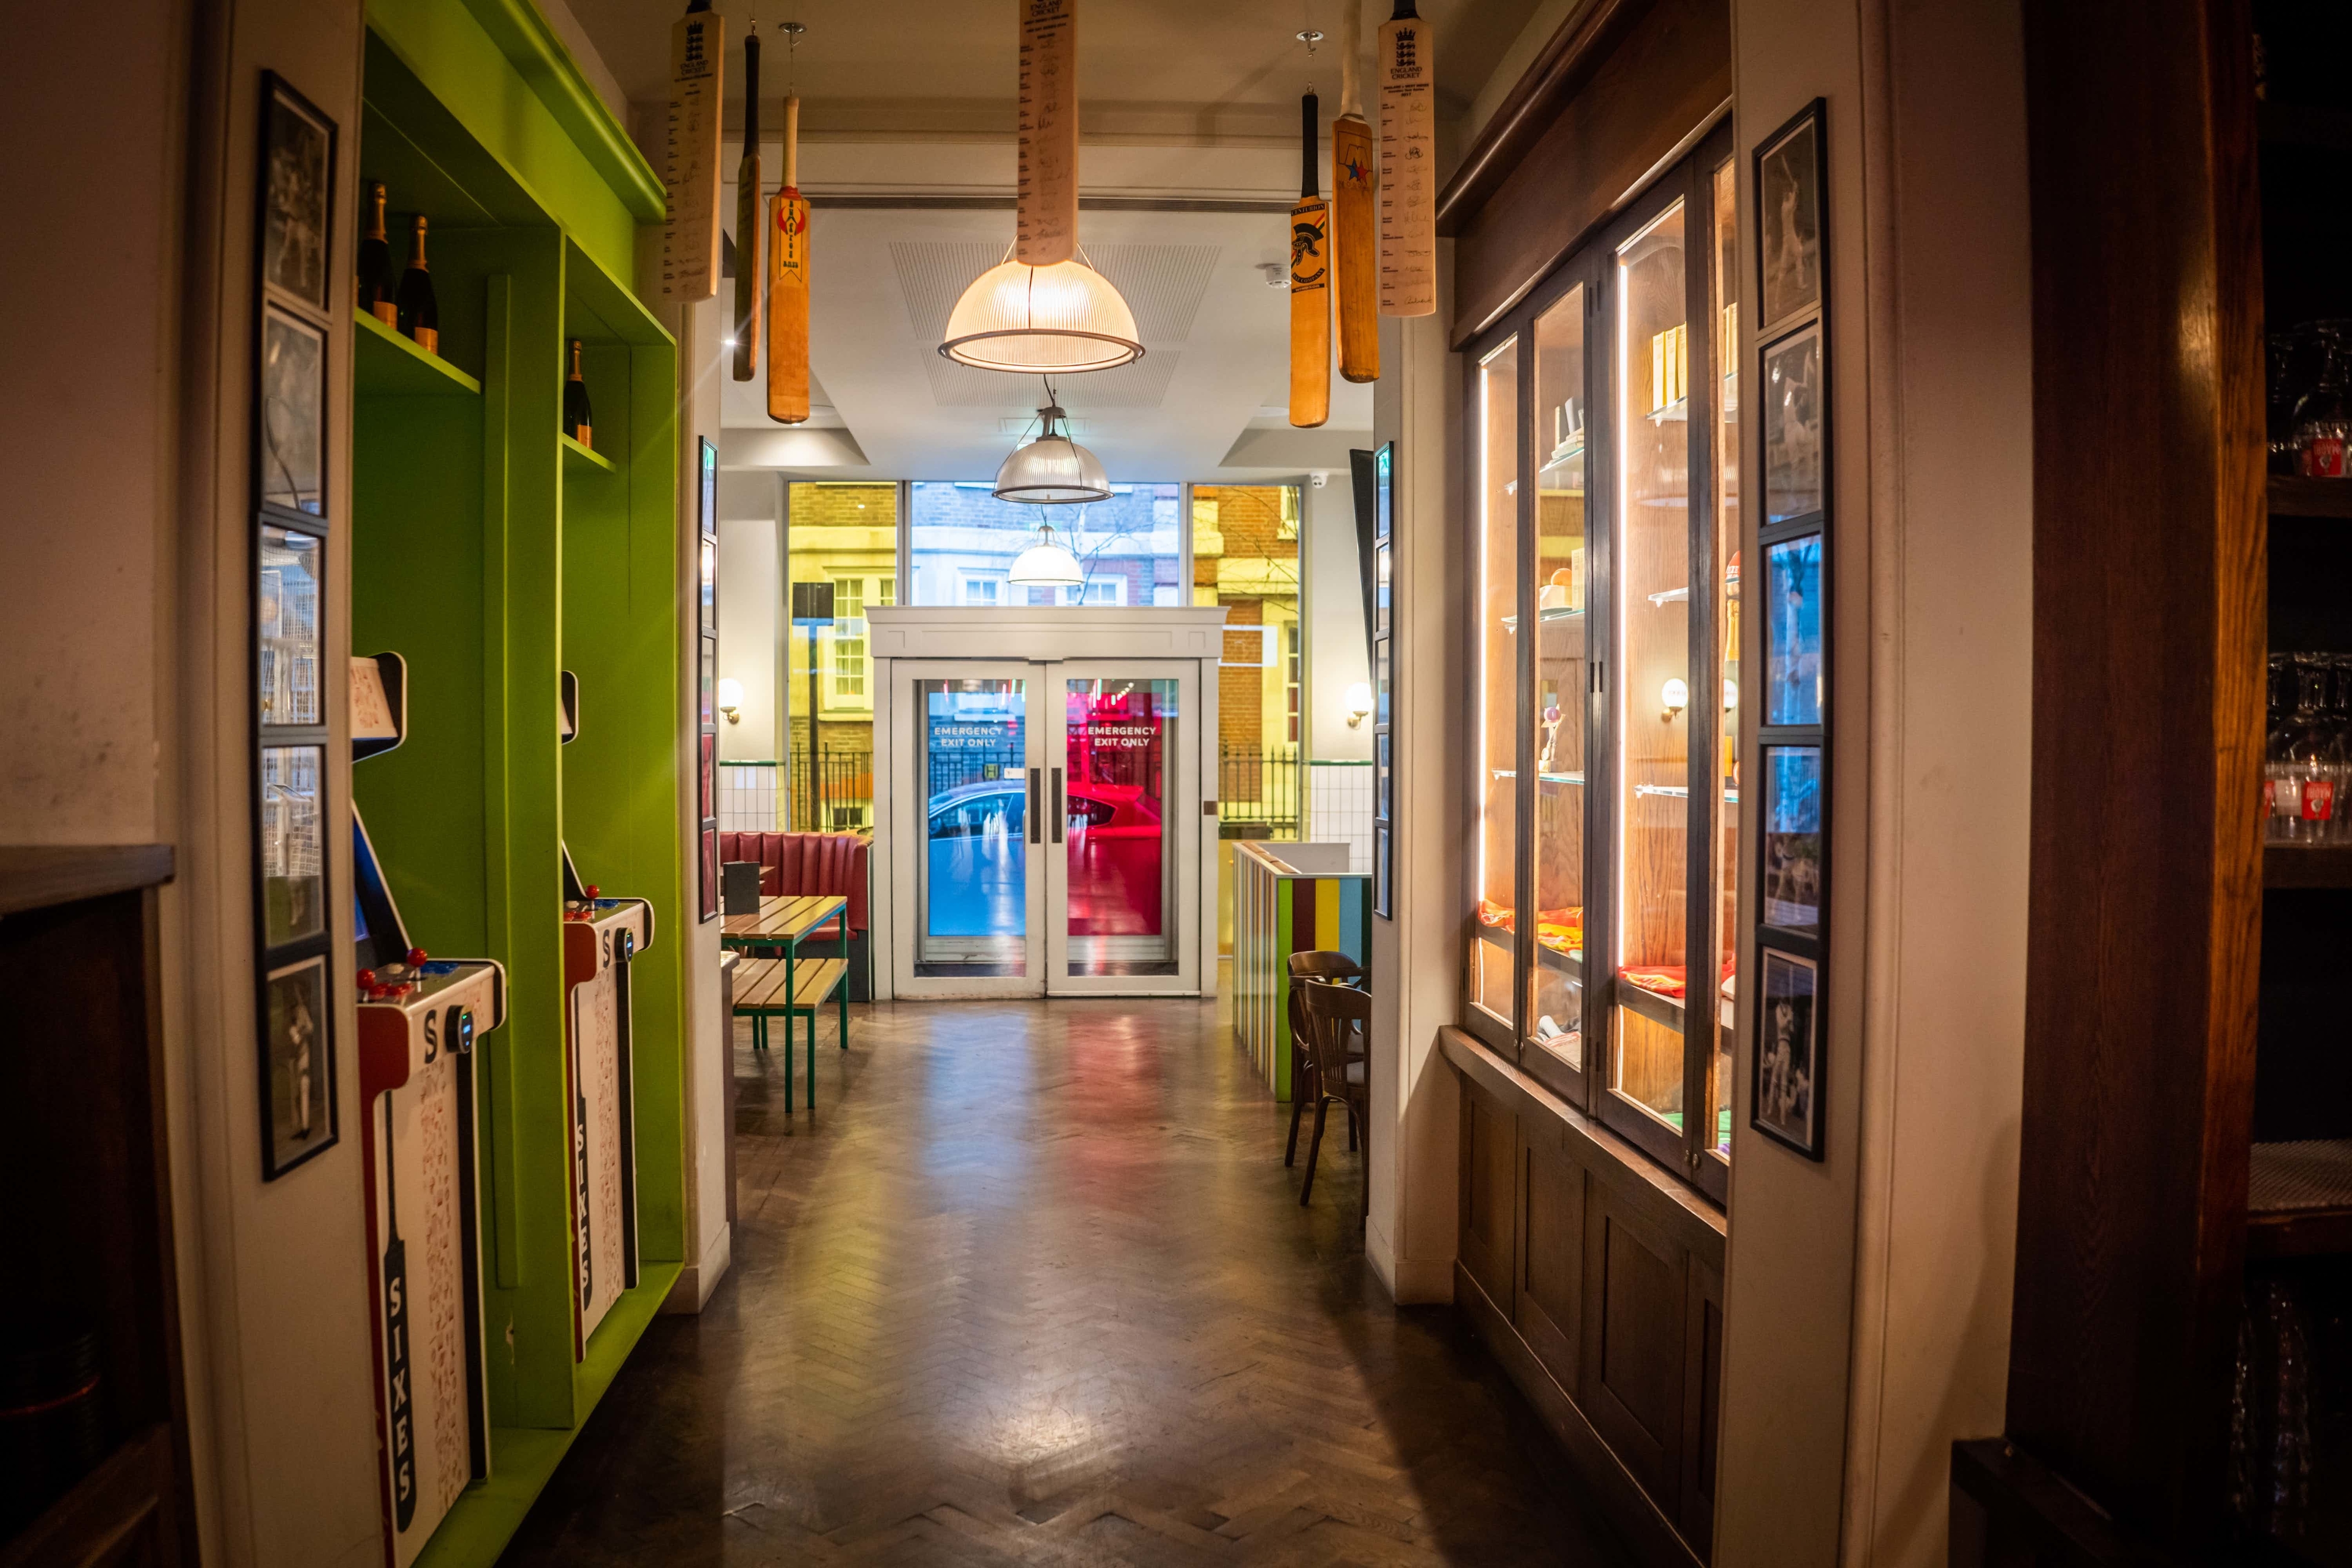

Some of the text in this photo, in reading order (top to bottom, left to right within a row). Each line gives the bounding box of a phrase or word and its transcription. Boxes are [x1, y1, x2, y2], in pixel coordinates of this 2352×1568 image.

[1030, 0, 1062, 10] ENGLAND
[1032, 6, 1059, 17] CRICKET
[680, 60, 709, 70] ENGLAND
[681, 66, 706, 75] CRICKET
[1291, 205, 1324, 215] CENTURION
[1300, 270, 1324, 283] COMPANY
[1088, 726, 1156, 735] EMERGENCY
[987, 766, 997, 777] H
[390, 1276, 411, 1502] SIXES
